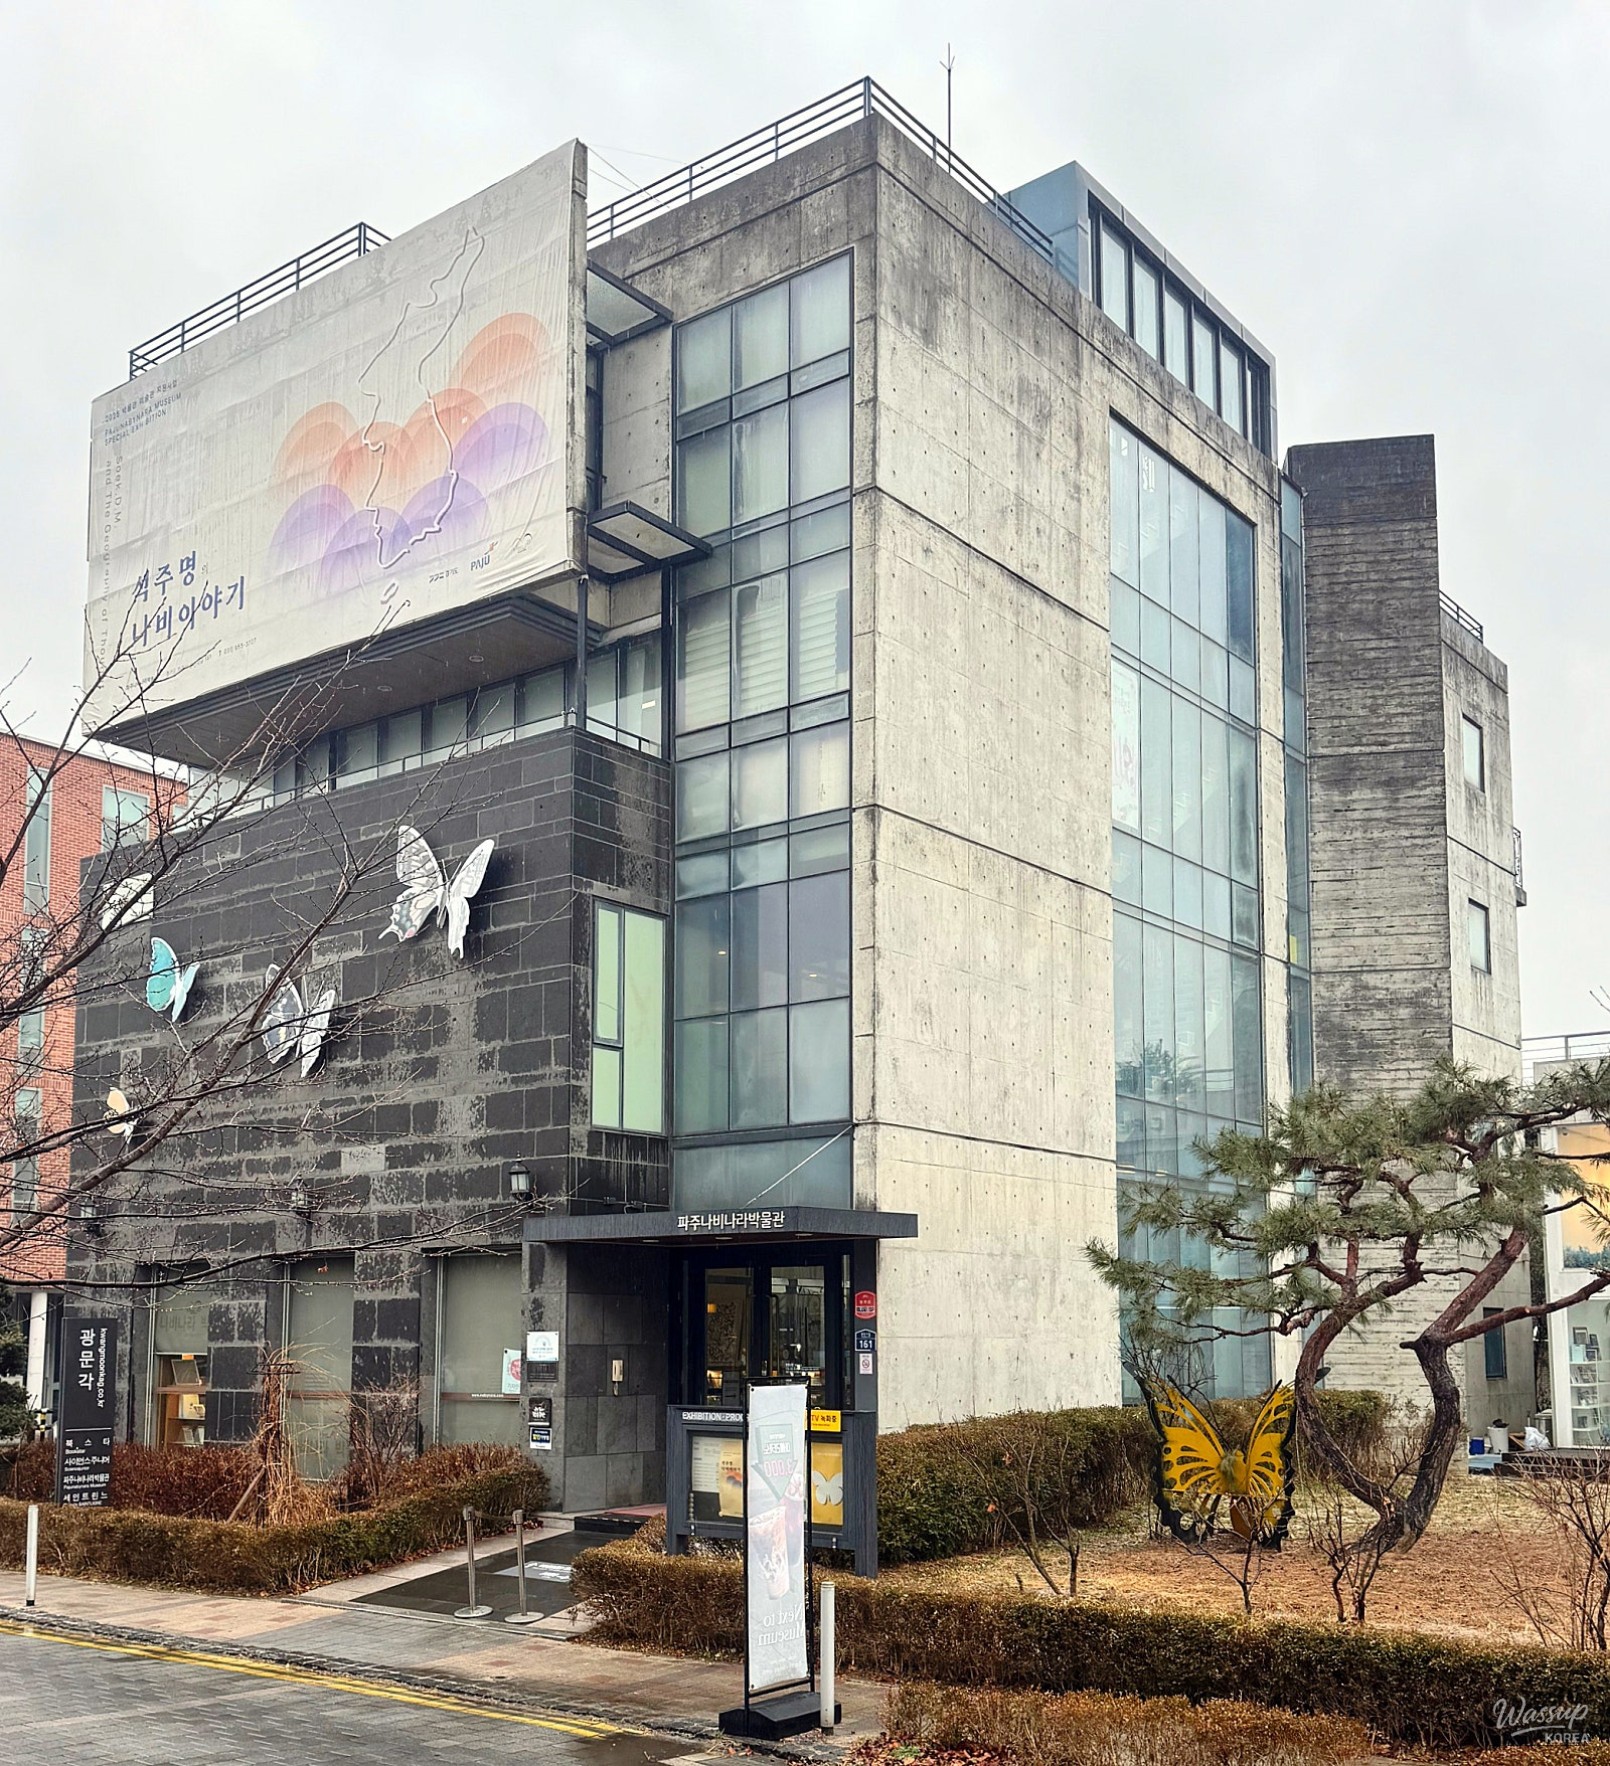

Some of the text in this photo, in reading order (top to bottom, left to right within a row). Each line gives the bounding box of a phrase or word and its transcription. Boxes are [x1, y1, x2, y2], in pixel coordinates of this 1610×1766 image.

[154, 392, 182, 409] MUSEUM
[105, 460, 113, 485] and
[104, 491, 113, 519] The
[470, 554, 491, 572] PAJU
[132, 550, 196, 602] 석주명
[132, 575, 245, 648] 나비이야기
[677, 1210, 785, 1231] 파주나비나라박물관
[859, 1340, 873, 1349] 161
[78, 1327, 96, 1392] 광문각
